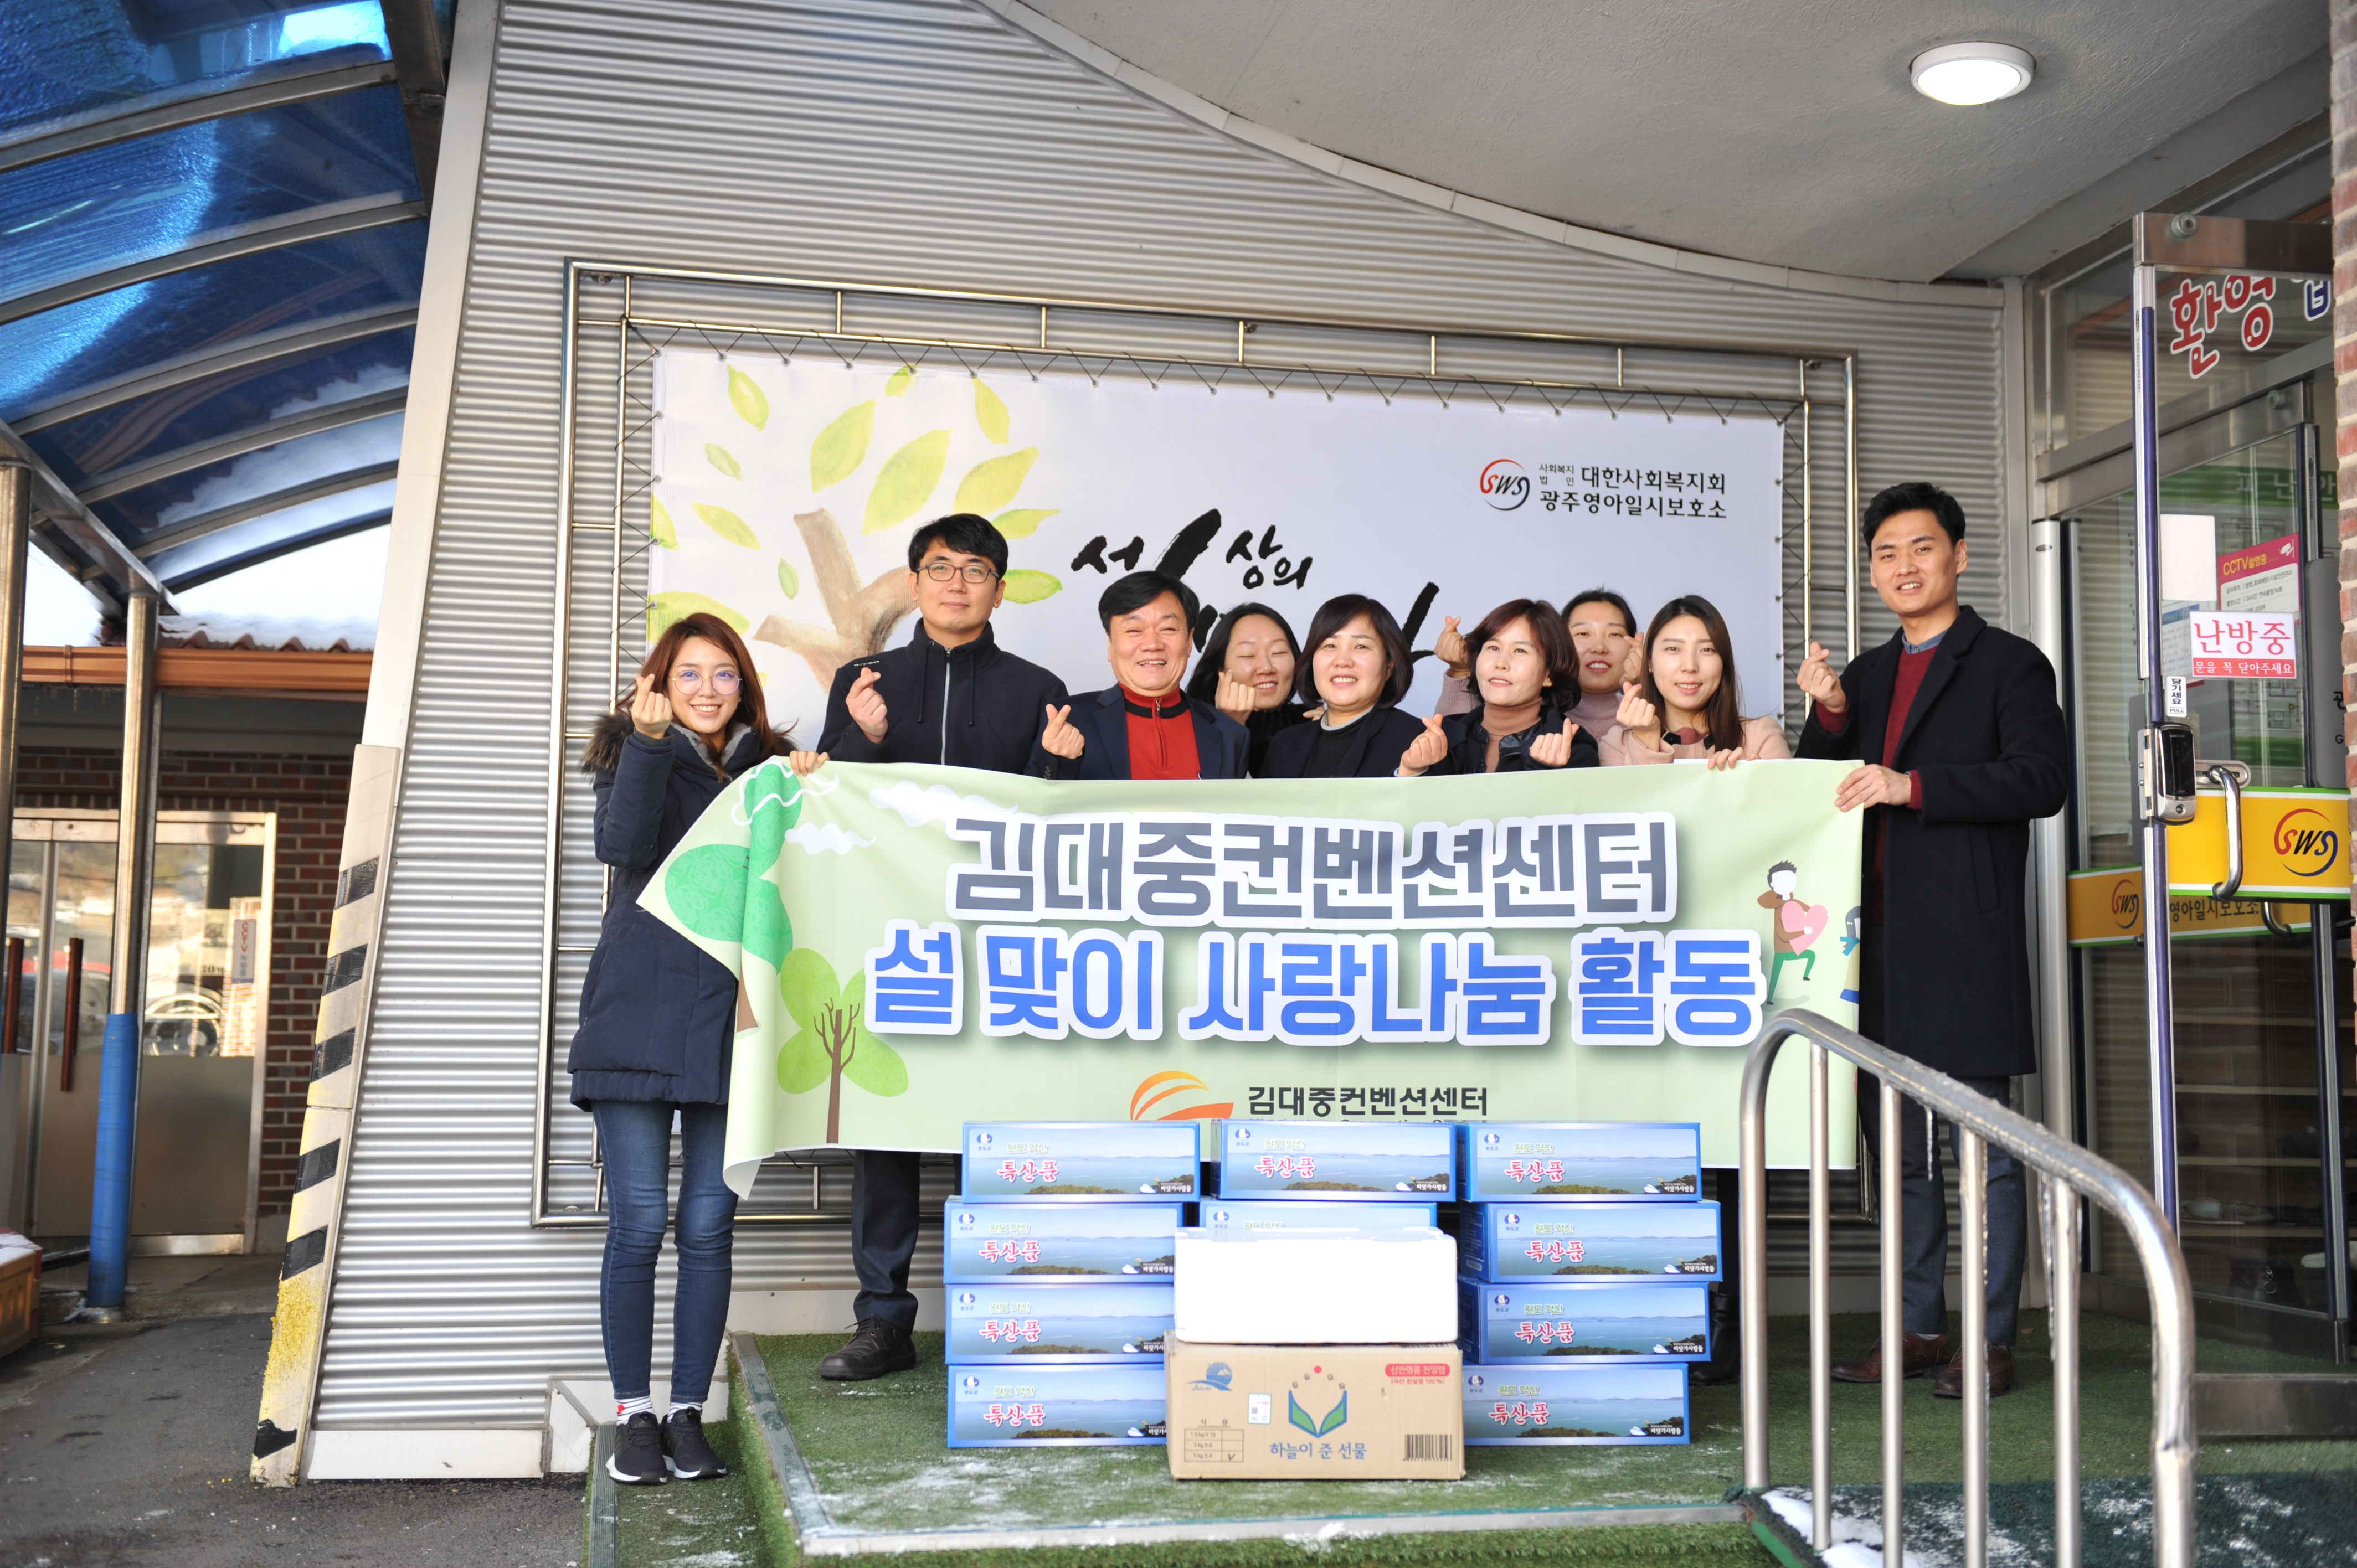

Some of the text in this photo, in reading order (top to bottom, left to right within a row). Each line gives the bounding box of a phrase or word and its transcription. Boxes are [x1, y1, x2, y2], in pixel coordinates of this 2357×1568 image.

[1539, 463, 1574, 474] 사회복지
[1581, 467, 1726, 494] 대한사회복지회
[1540, 491, 1727, 518] 광주영아일시보호소
[2194, 620, 2291, 656] 난방중
[2195, 661, 2293, 674] 문을 꼭 닫아주세요
[2171, 678, 2181, 705] 당기세요
[954, 816, 1667, 920] 김대중컨벤션센터
[873, 928, 1758, 1036] 설 맞이 사랑나눔 활동
[1248, 1087, 1488, 1117] 김대중컨벤션센터
[997, 1160, 1058, 1182] 특산품
[1255, 1156, 1315, 1178] 특산품
[1505, 1160, 1564, 1182] 특산품
[979, 1241, 1041, 1263] 특산품
[1525, 1241, 1585, 1262] 특산품
[980, 1320, 1041, 1342] 특산품
[1515, 1321, 1574, 1344] 특산품
[984, 1404, 1046, 1427] 특산품
[1489, 1402, 1550, 1425] 특산품
[1269, 1442, 1367, 1459] 하늘이 준 선물
